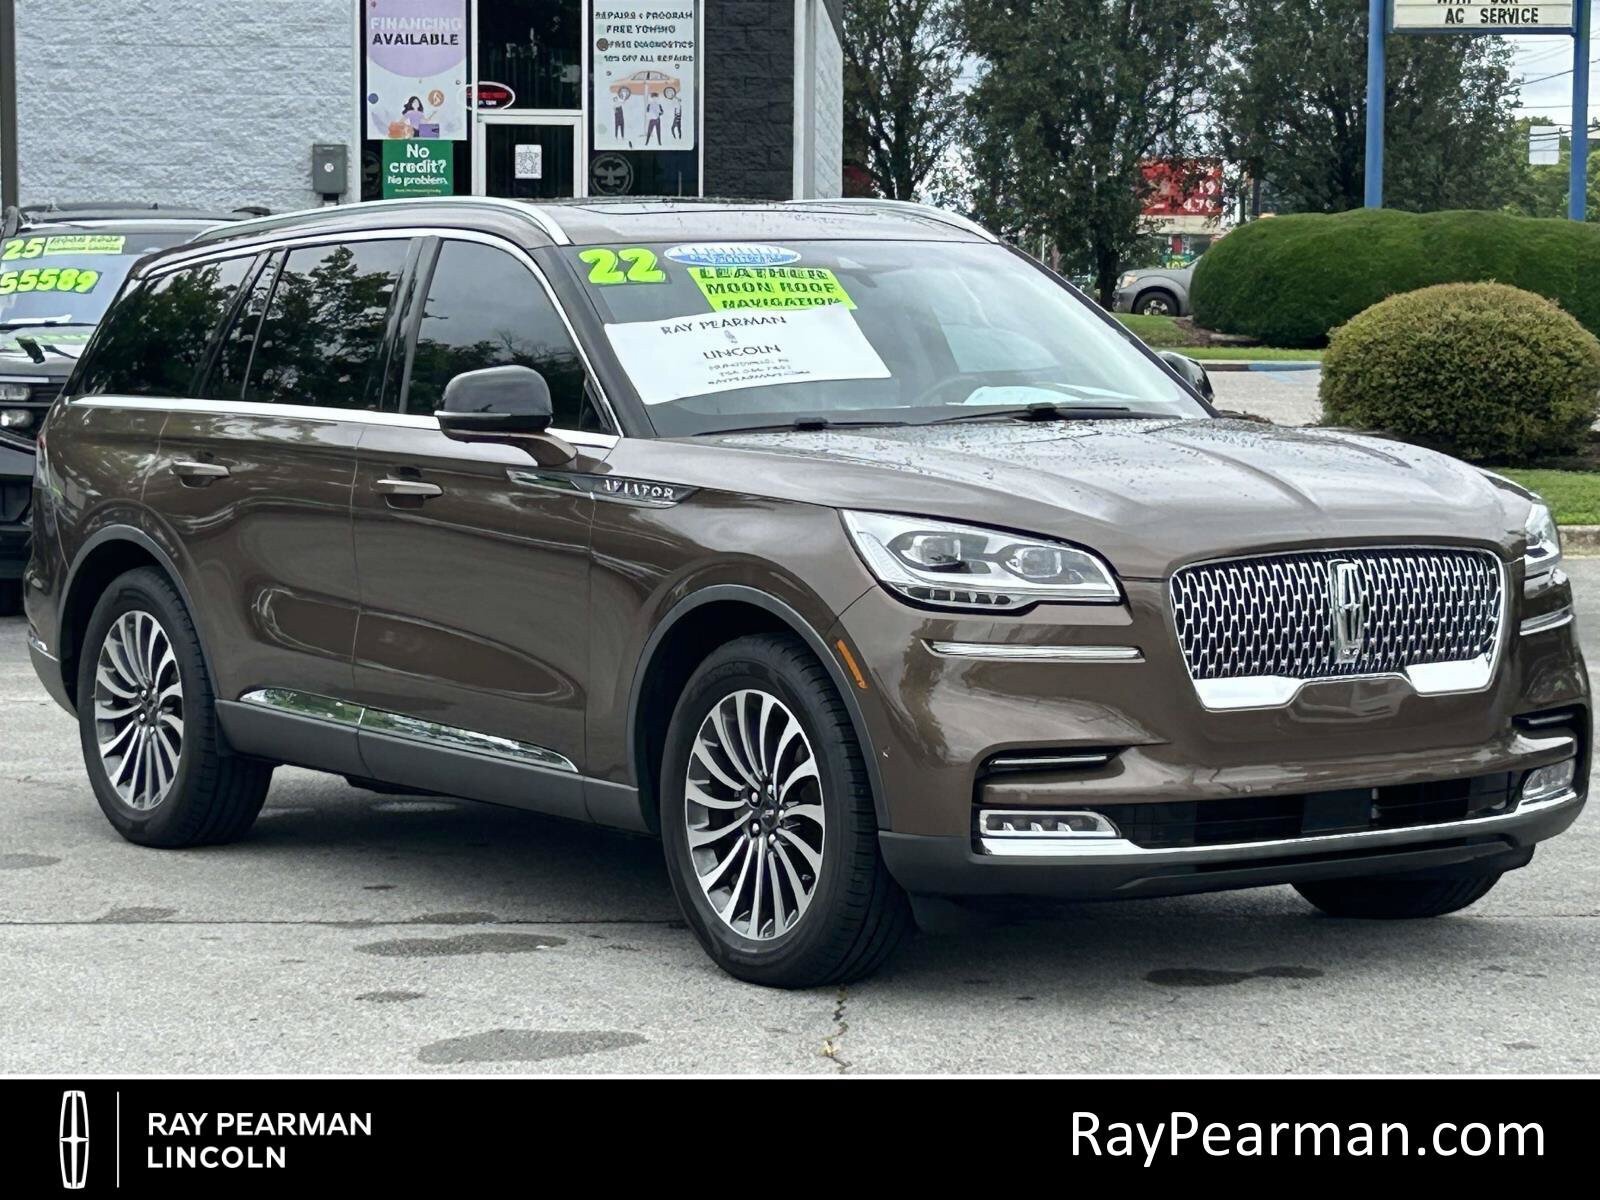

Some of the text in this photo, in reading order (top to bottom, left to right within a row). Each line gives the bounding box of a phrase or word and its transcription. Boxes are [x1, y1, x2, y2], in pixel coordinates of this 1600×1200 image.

[370, 17, 462, 30] FINANCING
[1445, 8, 1539, 24] AC SERVICE
[372, 33, 459, 46] AVAILABLE
[406, 143, 430, 158] No
[389, 159, 447, 173] credit?
[387, 175, 402, 184] No
[2, 238, 45, 260] 25
[578, 248, 666, 284] 22
[700, 268, 829, 280] LEATHER
[707, 282, 838, 295] MOON ROOF
[660, 316, 787, 335] RAY PEARMAN
[703, 344, 782, 360] LINCOLN
[604, 479, 674, 499] AVIATOR
